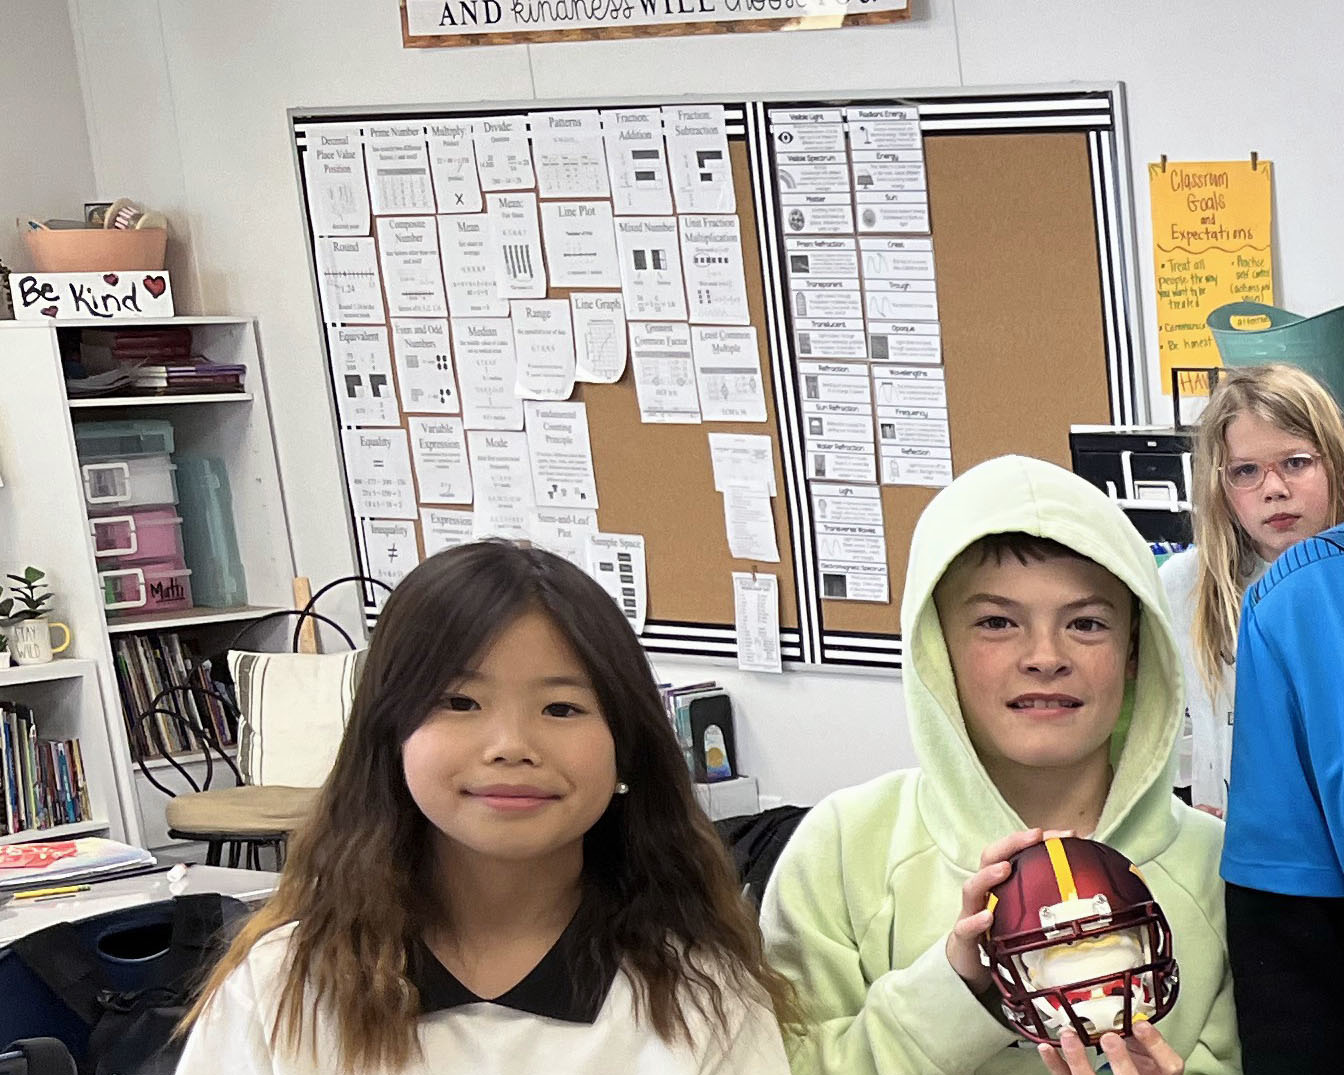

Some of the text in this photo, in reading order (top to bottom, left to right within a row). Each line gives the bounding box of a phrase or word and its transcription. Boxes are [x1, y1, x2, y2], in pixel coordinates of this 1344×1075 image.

[439, 0, 501, 26] AND
[809, 113, 824, 122] Light
[858, 110, 907, 119] Radiant Energy
[548, 117, 582, 128] Patterns
[370, 127, 420, 138] Prime Number
[618, 130, 652, 141] Addition
[675, 126, 719, 137] Subtraction
[316, 149, 356, 160] Place Value
[807, 154, 836, 163] Spectrum
[876, 152, 899, 162] Energy
[323, 164, 352, 174] Position
[1187, 193, 1226, 213] Goals
[558, 206, 596, 217] Line Plot
[703, 218, 735, 228] Fraction
[1200, 215, 1216, 226] and
[389, 220, 426, 233] Composite
[456, 222, 480, 232] Mean
[618, 222, 676, 233] Mixed Number
[394, 234, 423, 243] Number
[685, 233, 738, 245] Multiplication
[1171, 223, 1254, 246] Expectations
[333, 242, 359, 252] Round
[1168, 258, 1206, 272] Treat all
[806, 280, 843, 289] Transparent
[1158, 276, 1188, 290] people
[1190, 273, 1204, 285] the
[19, 276, 143, 318] Be Kind
[1157, 289, 1170, 299] you
[1172, 288, 1188, 297] want
[575, 298, 622, 312] Line Graph
[1168, 296, 1200, 309] treated
[525, 307, 552, 322] Range
[414, 325, 427, 335] and
[429, 325, 443, 335] Odd
[811, 321, 847, 329] Translucent
[467, 325, 498, 337] Median
[700, 329, 751, 341] Least Common
[338, 331, 380, 343] Equivalent
[403, 339, 437, 348] Numbers
[712, 343, 741, 355] Multiple
[1168, 336, 1213, 351] Be honest
[815, 403, 859, 412] Sun Refraction
[895, 408, 929, 418] Frequency
[535, 409, 577, 419] Fundamental
[420, 423, 454, 434] Variable
[542, 423, 572, 434] Counting
[359, 436, 392, 449] Equality
[419, 438, 461, 451] Expression
[485, 437, 509, 448] Mode
[370, 524, 408, 537] Inequality
[557, 527, 573, 538] Plot
[591, 536, 642, 549] Sample Space
[150, 577, 185, 599] Math
[15, 627, 37, 643] STAY
[16, 643, 41, 659] WILD
